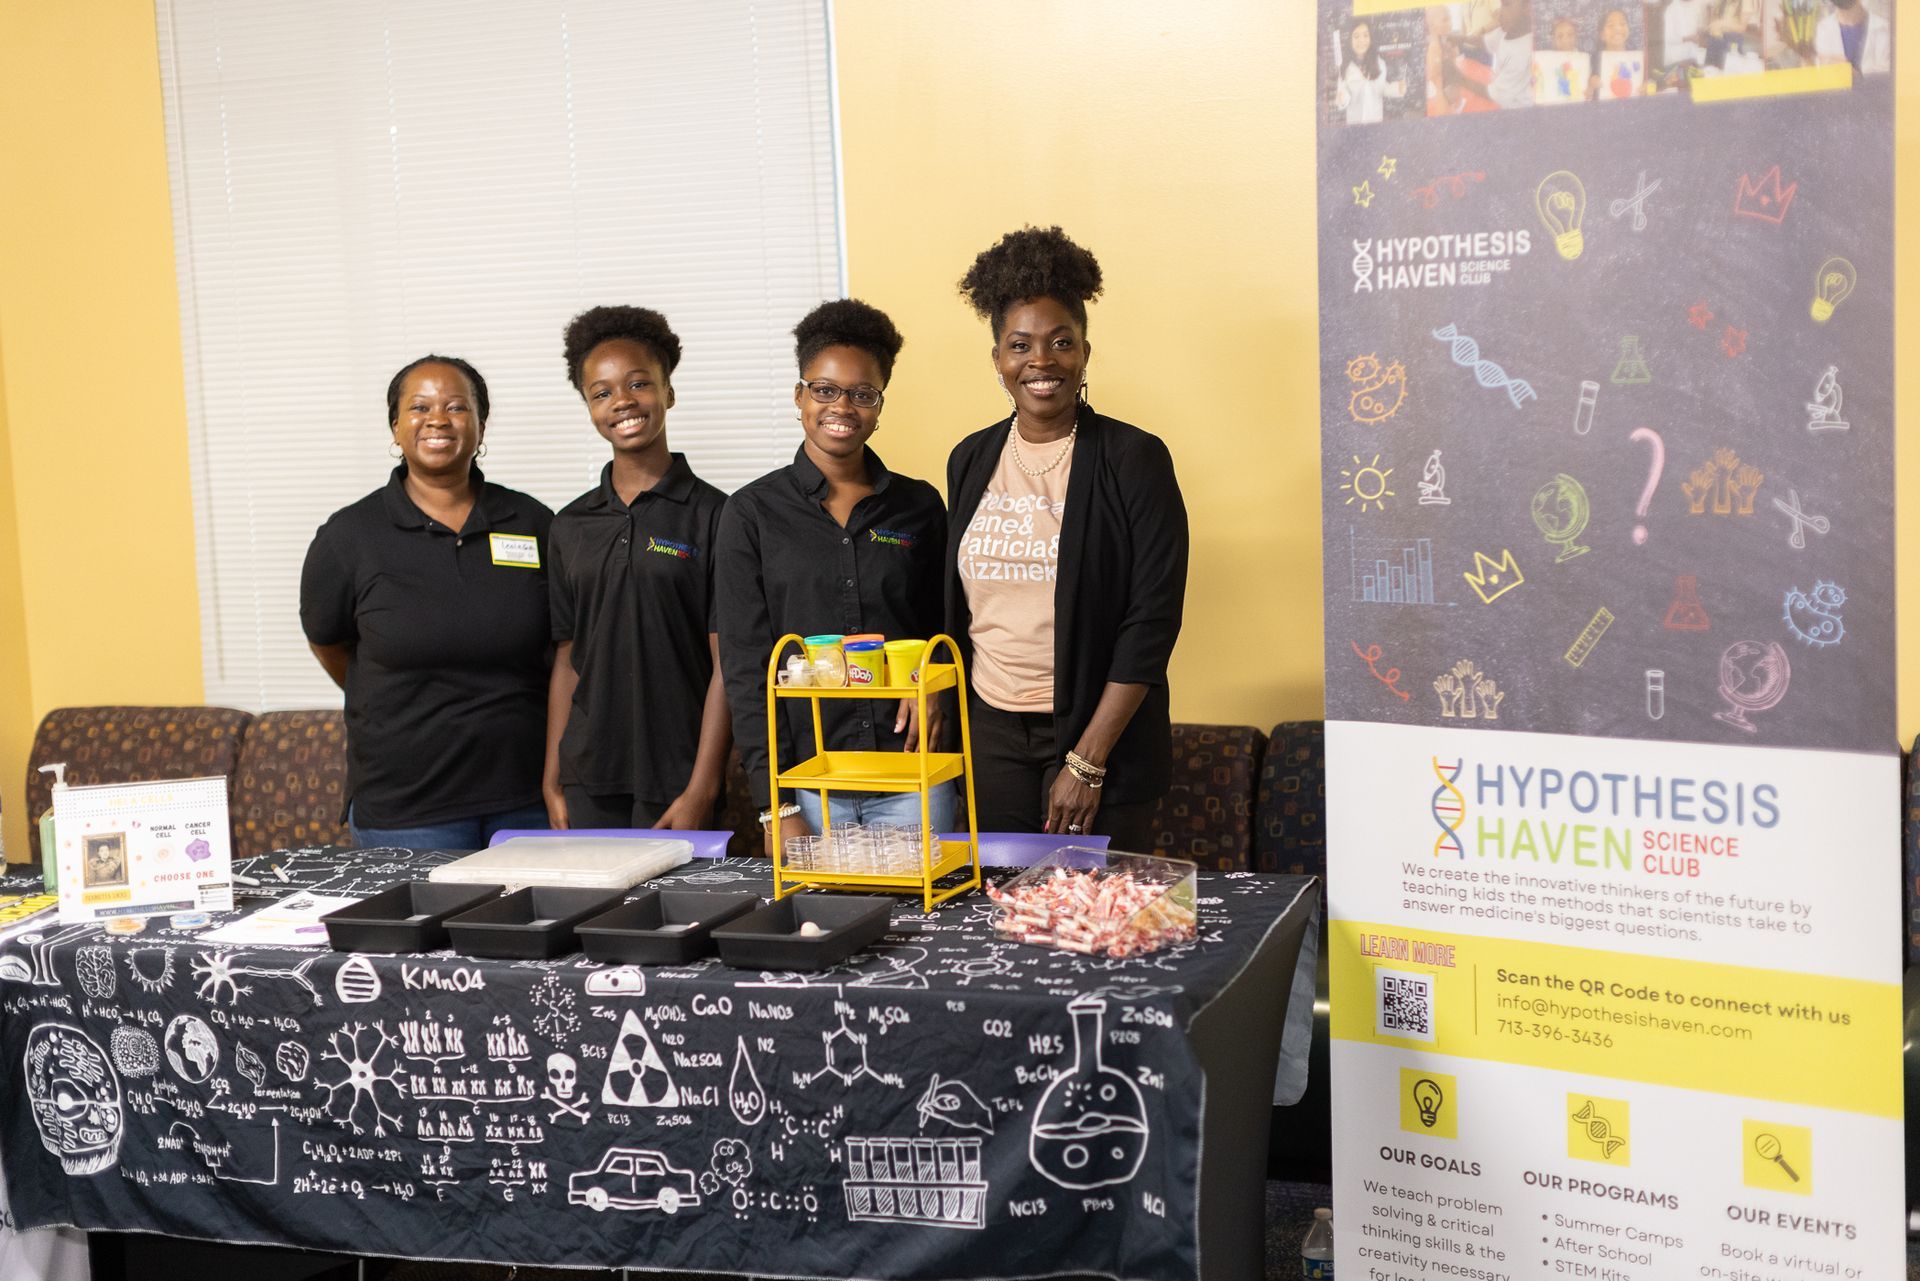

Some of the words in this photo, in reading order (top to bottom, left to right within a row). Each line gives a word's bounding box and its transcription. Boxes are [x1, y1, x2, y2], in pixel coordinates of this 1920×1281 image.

[1377, 229, 1532, 263] HYPOTHESIS
[1377, 262, 1456, 290] HAVEN
[1460, 259, 1511, 273] SCIENCE
[1460, 271, 1492, 286] CLUB
[653, 544, 678, 557] HAVEN
[1476, 763, 1781, 829] HYPOTHESIS
[150, 824, 176, 832] NORMAL
[185, 821, 211, 830] CANCER
[1477, 815, 1632, 871] HAVEN
[1643, 830, 1740, 857] SCIENCE
[196, 870, 215, 880] ONE
[1643, 854, 1700, 878] CLUB
[154, 873, 191, 883] CHOOSE
[1402, 862, 1425, 877] We
[1429, 866, 1479, 883] create
[1484, 870, 1510, 885] the
[1515, 872, 1597, 894] innovative
[1601, 883, 1669, 902] thinkers
[1674, 889, 1692, 904] of
[1696, 891, 1724, 907] the
[1730, 894, 1784, 913] future
[1790, 900, 1812, 918] by
[1402, 881, 1468, 901] teaching
[1473, 886, 1505, 903] kids
[1510, 890, 1536, 905] the
[1542, 893, 1613, 915] methods
[1619, 903, 1654, 919] that
[1659, 907, 1742, 928] scientists
[1748, 915, 1787, 932] take
[1793, 919, 1812, 934] to
[1402, 899, 1455, 915] answer
[1460, 903, 1545, 924] medicine's
[1550, 911, 1610, 932] biggest
[1615, 922, 1702, 942] questions.
[1360, 933, 1409, 961] LEARN
[1412, 940, 1456, 968] MORE
[401, 963, 486, 993] KMnO4
[692, 993, 733, 1016] CaO
[1497, 968, 1540, 987] Scan
[1545, 974, 1575, 991] the
[1579, 978, 1604, 997] QR
[1610, 983, 1659, 1003] Code
[1665, 989, 1685, 1006] to
[1690, 995, 1772, 1016] connect
[1778, 1002, 1822, 1022] with
[1828, 1011, 1851, 1026] us
[425, 1010, 432, 1020] 2
[447, 1014, 454, 1023] 3
[644, 1005, 687, 1030] Mg(OH)2
[748, 1001, 794, 1020] NaNO3
[868, 1006, 910, 1035] MgSO4
[1121, 1006, 1173, 1028] ZnSO4
[1497, 994, 1753, 1040] info@hypothesishaven.com
[273, 1016, 301, 1033] H2CO3
[983, 1019, 1013, 1038] CO2
[1497, 1019, 1614, 1049] 713-396-3436
[662, 1033, 685, 1046] N2O
[757, 1037, 776, 1054] N2
[1028, 1034, 1064, 1054] H2S
[673, 1051, 723, 1068] Na2SO4
[681, 1087, 719, 1106] NaCl
[735, 1092, 759, 1114] H2O
[656, 1115, 692, 1127] ZnSO4
[720, 1145, 734, 1156] CO
[1379, 1146, 1416, 1166] OUR
[1420, 1153, 1482, 1177] GOALS
[726, 1160, 743, 1173] CO2
[393, 1181, 415, 1202] H2O
[1363, 1179, 1388, 1195] We
[1391, 1183, 1433, 1205] teach
[1438, 1193, 1503, 1217] problem
[1523, 1170, 1563, 1191] OUR
[1568, 1178, 1680, 1210] PROGRAMS
[1143, 1191, 1165, 1218] HCl
[1372, 1204, 1423, 1227] solving
[1427, 1213, 1437, 1227] &
[1441, 1216, 1494, 1237] critical
[1554, 1213, 1621, 1237] Summer
[1625, 1226, 1684, 1249] Camps
[1728, 1205, 1770, 1226] OUR
[1777, 1213, 1857, 1240] EVENTS
[1362, 1223, 1421, 1248] thinking
[1425, 1236, 1461, 1254] skills
[1465, 1242, 1476, 1256] &
[1480, 1245, 1506, 1262] the
[1555, 1236, 1594, 1255] After
[1598, 1243, 1652, 1266] School
[1358, 1246, 1428, 1271] creativity
[1431, 1261, 1511, 1281] necessary
[1555, 1258, 1596, 1280] STEM
[1602, 1269, 1632, 1281] Kits
[1721, 1243, 1763, 1262] Book
[1768, 1254, 1778, 1265] a
[1784, 1255, 1839, 1275] virtual
[1844, 1267, 1863, 1279] or
[1369, 1267, 1390, 1281] for
[1700, 1265, 1761, 1281] on-site
